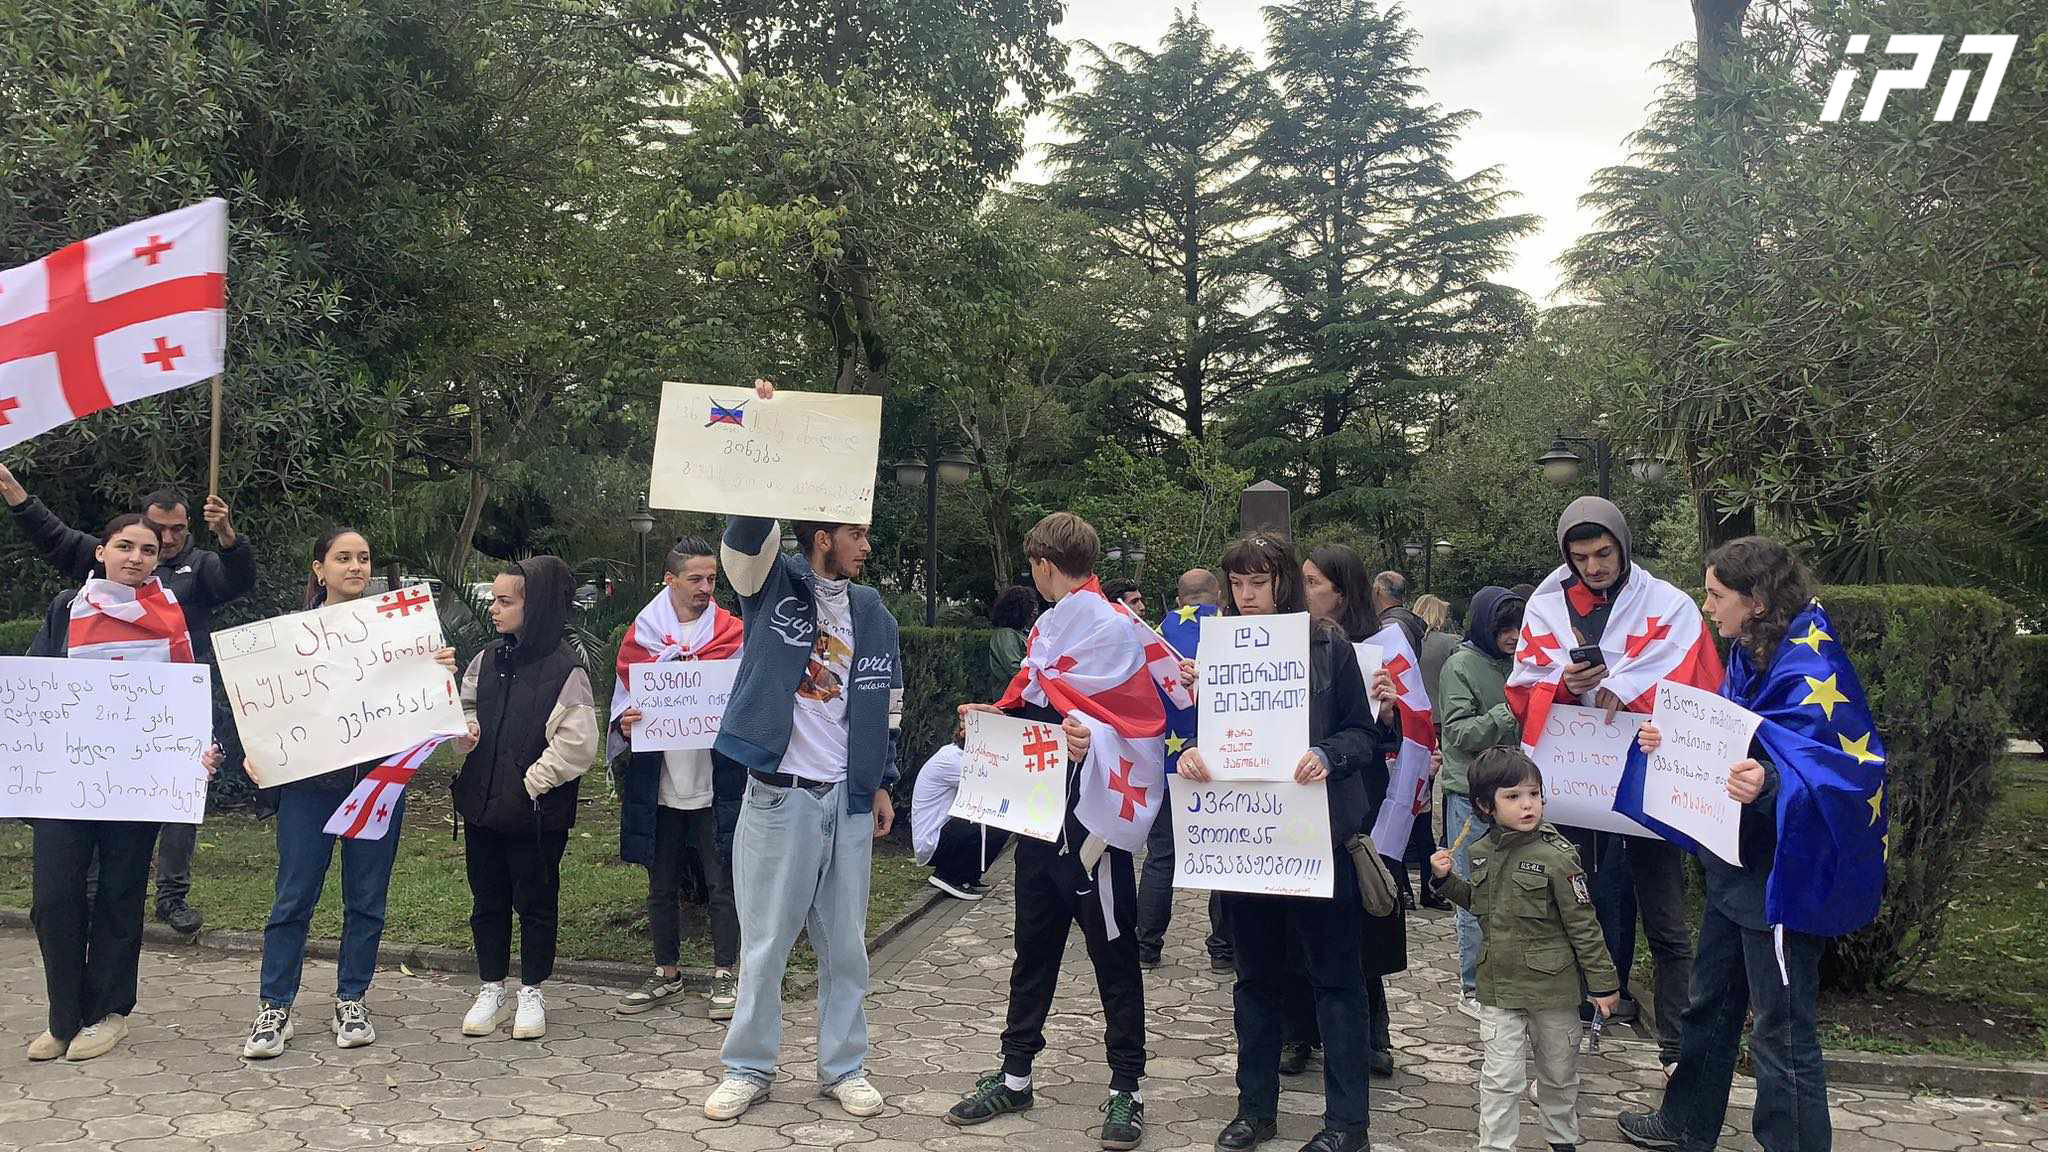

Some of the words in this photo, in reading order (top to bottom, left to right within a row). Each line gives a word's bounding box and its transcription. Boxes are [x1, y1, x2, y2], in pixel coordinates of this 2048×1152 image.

[295, 611, 368, 656] არა
[1234, 626, 1270, 648] და
[643, 671, 702, 692] ფაზისი
[1208, 660, 1306, 686] ემიგრაცია
[235, 664, 331, 717] რუსულ
[708, 693, 733, 706] იქნ
[275, 726, 307, 766] კი
[1553, 746, 1618, 766] რუსულ
[1188, 825, 1276, 844] ფოთიდან
